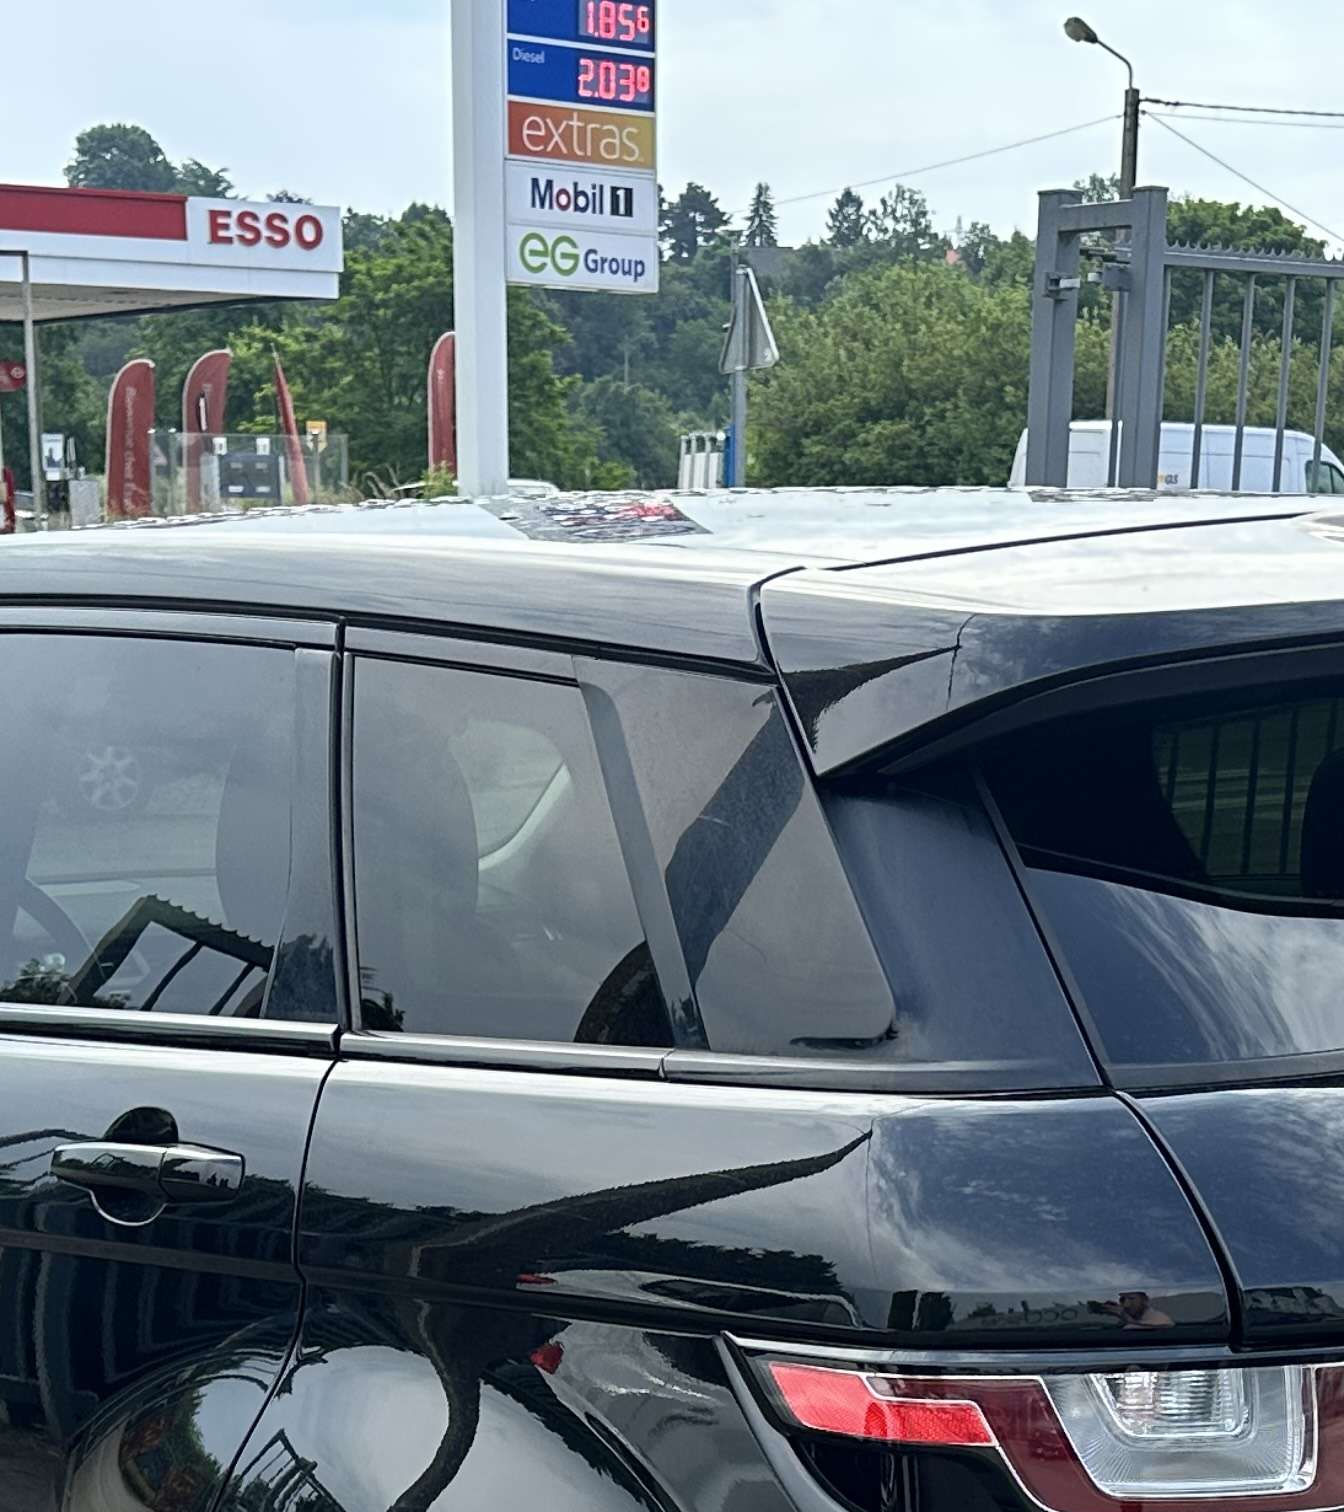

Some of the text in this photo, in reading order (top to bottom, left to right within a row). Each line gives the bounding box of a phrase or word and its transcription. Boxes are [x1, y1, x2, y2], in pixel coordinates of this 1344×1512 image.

[585, 1, 649, 41] 1.856
[512, 47, 545, 64] Diesel
[578, 58, 650, 101] 2.038
[522, 111, 640, 162] extras
[531, 177, 630, 217] Mobil 1
[208, 209, 323, 250] ESSO
[583, 248, 646, 282] Group
